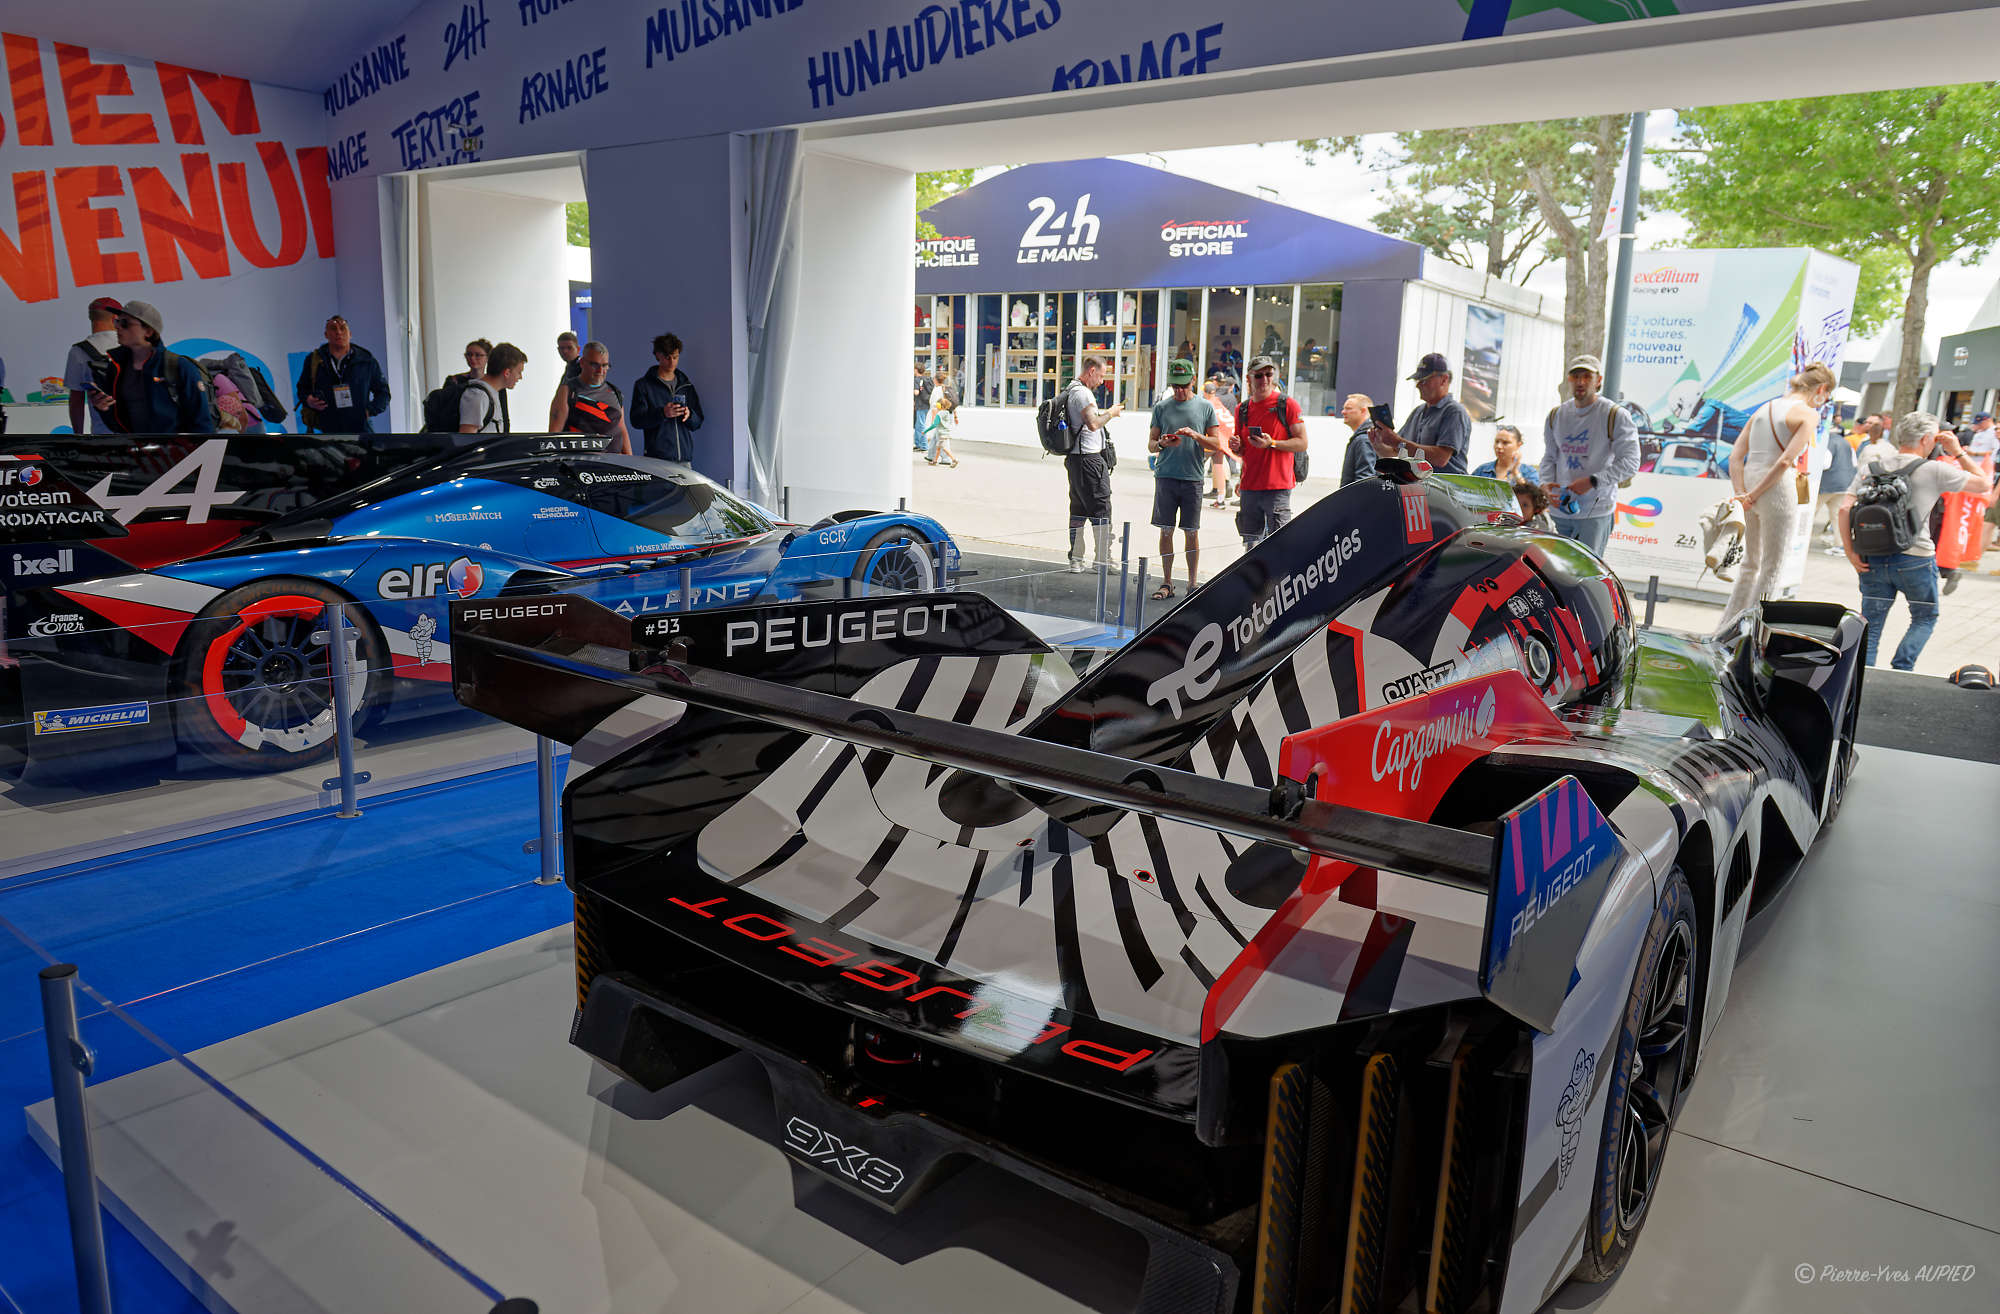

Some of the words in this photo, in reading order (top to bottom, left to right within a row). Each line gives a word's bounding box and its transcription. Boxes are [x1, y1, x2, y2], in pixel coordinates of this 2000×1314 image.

[646, 0, 803, 68] MULSA
[0, 31, 261, 147] IEN
[518, 47, 609, 125] ARNAGE
[391, 90, 484, 168] TERTRE
[1020, 193, 1100, 248] 24h
[1161, 224, 1248, 241] OFFICIAL
[1017, 249, 1039, 263] LE
[1169, 241, 1233, 257] STORE
[1634, 269, 1699, 284] excellium
[1661, 286, 1679, 294] evo
[1628, 343, 1682, 352] nouveau
[545, 440, 603, 449] ALTEN
[592, 472, 652, 483] businessolver
[532, 511, 579, 519] TECHNOLOGY
[1404, 495, 1427, 532] HY
[819, 529, 847, 545] GCR
[12, 549, 74, 576] ixell
[378, 563, 446, 599] elf
[1227, 528, 1362, 652] TotalEnergies
[51, 613, 78, 622] France
[463, 604, 567, 621] PEUGEOT
[645, 619, 680, 636] #93
[726, 603, 957, 657] PEUGEOT
[1382, 659, 1456, 704] QUARTZ
[68, 710, 147, 725] MICHELIN
[1371, 695, 1477, 792] Capgemini
[1509, 844, 1596, 948] PEUGEOT
[667, 896, 1154, 1072] PEUGEOT
[785, 1116, 905, 1193] 9X8
